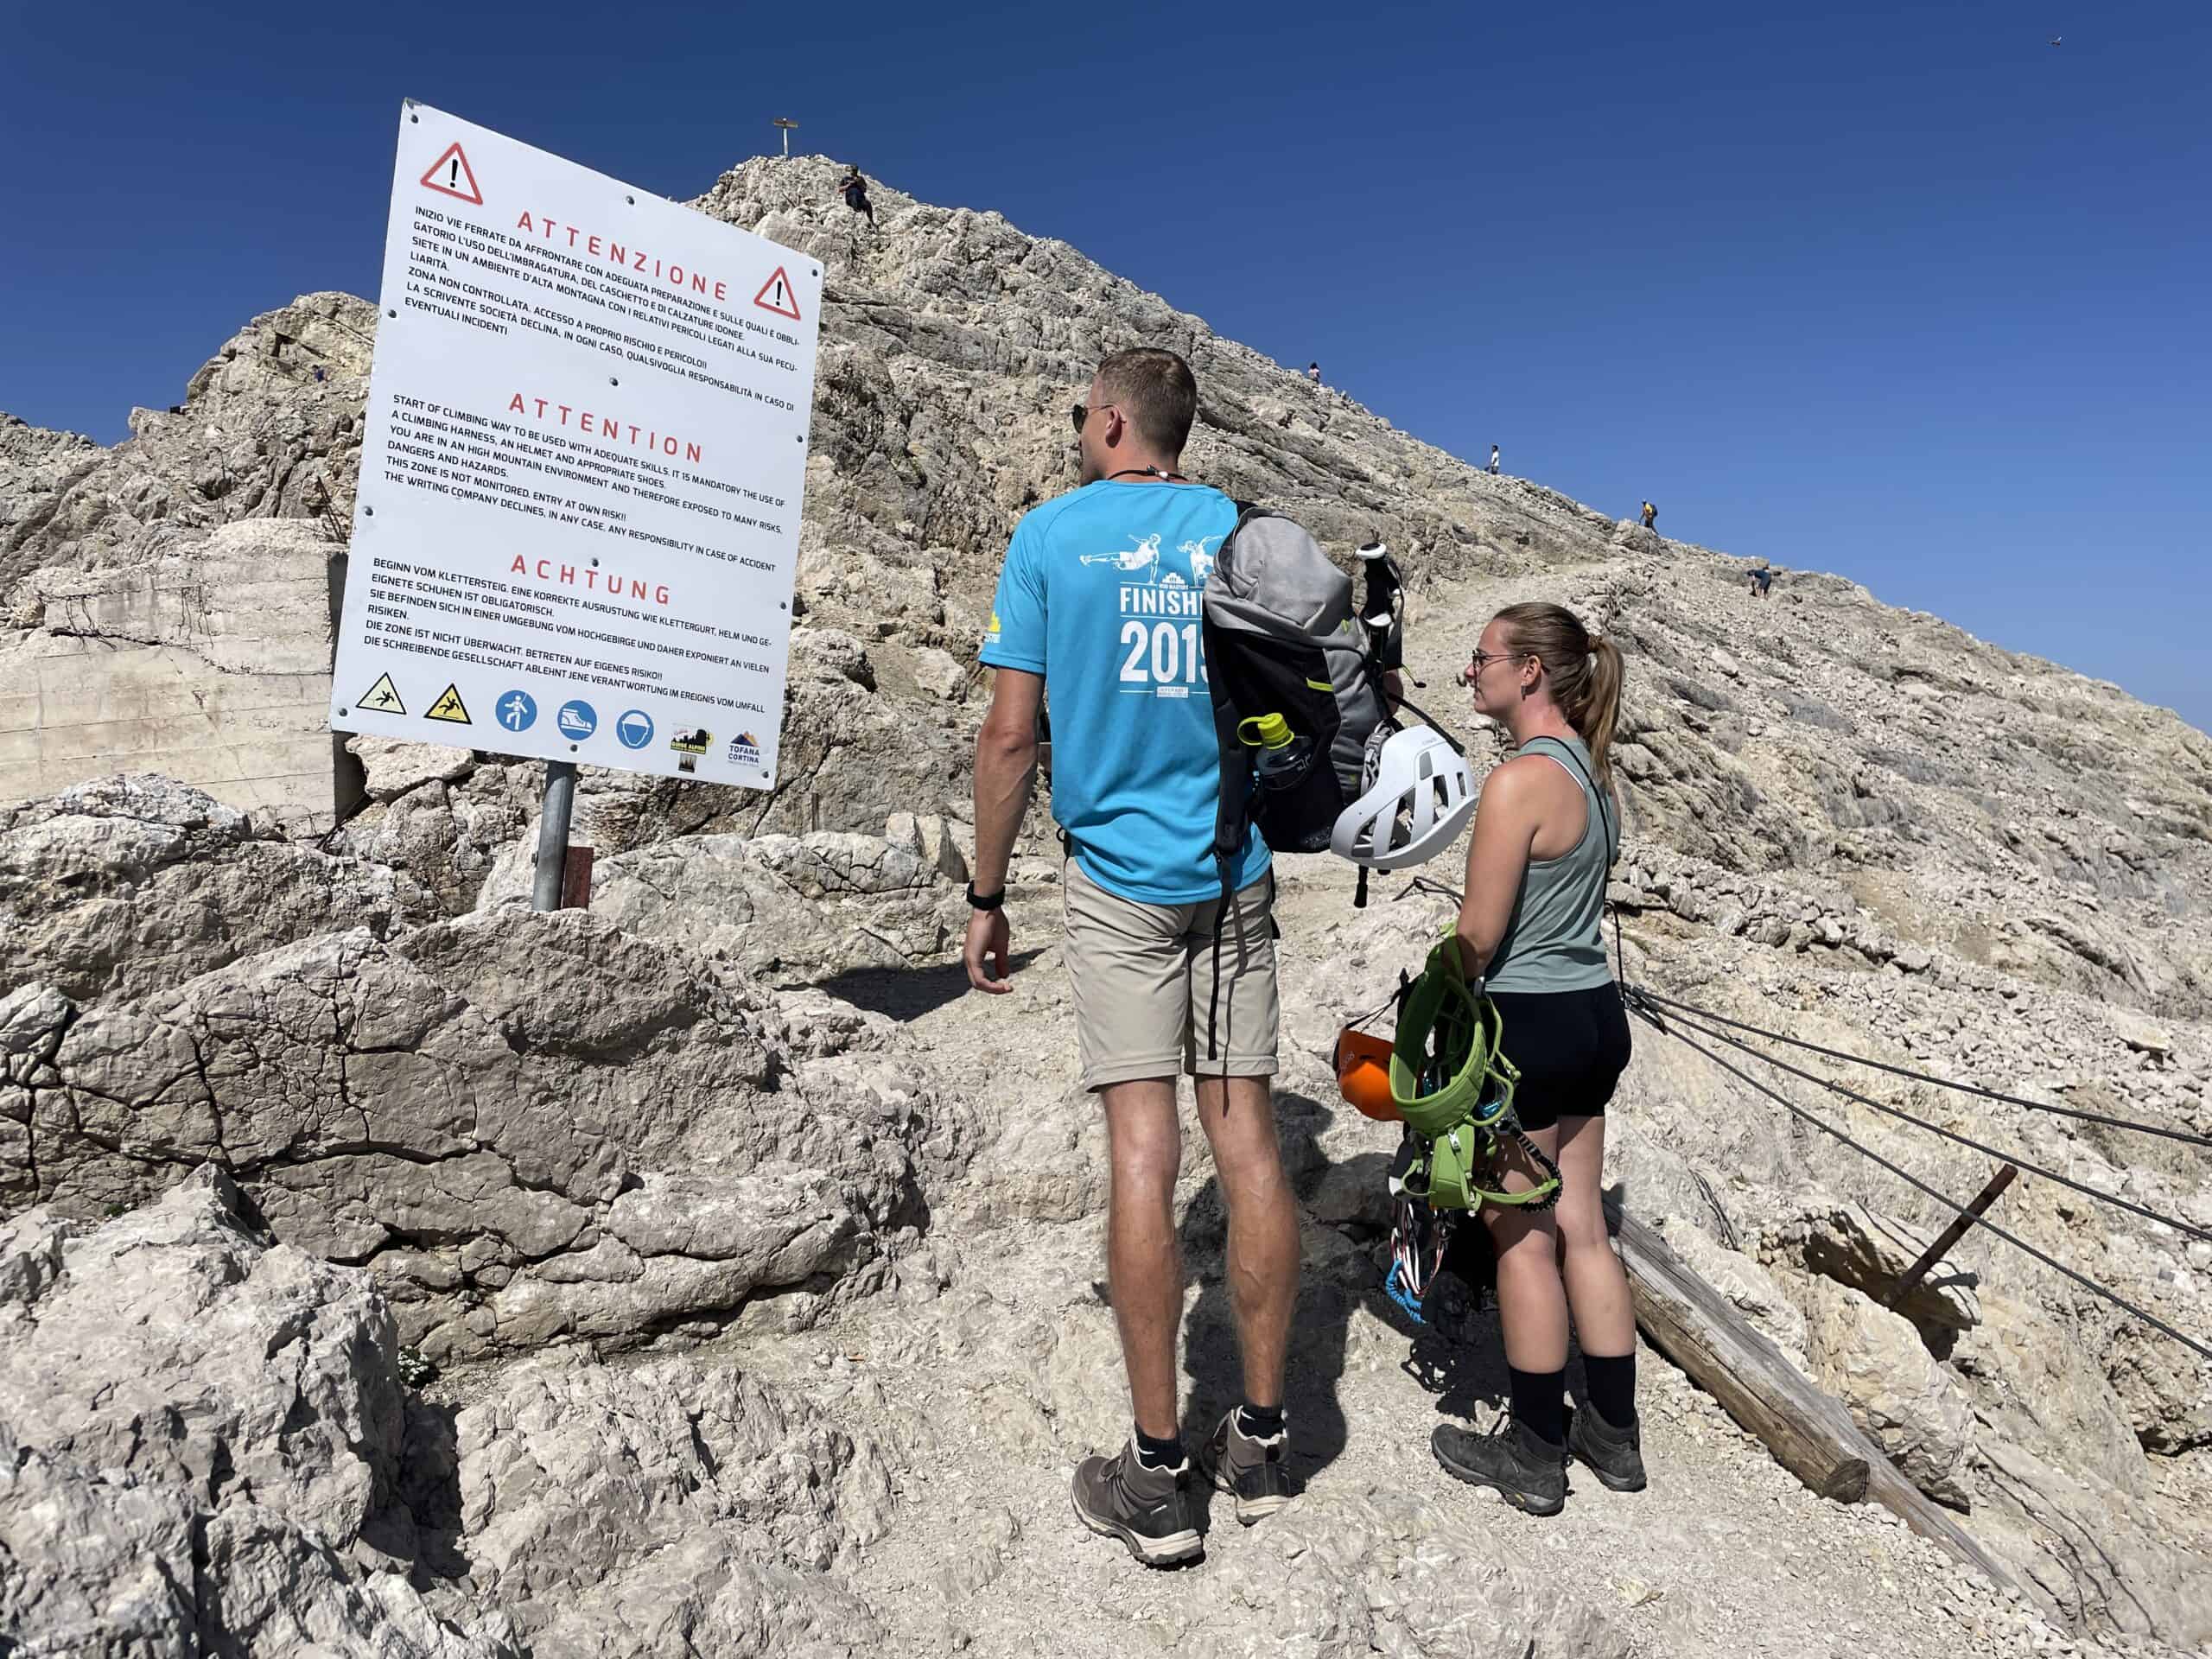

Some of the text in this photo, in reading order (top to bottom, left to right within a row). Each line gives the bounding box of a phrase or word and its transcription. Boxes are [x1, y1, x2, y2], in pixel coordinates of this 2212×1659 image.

[410, 250, 450, 271] LIARITÀ.
[413, 220, 456, 242] GATORIO
[458, 235, 486, 251] L'USO
[581, 276, 598, 290] DEL
[600, 283, 649, 308] CASCHETTO
[667, 307, 714, 330] CALZATURE
[415, 205, 799, 346] INIZIO VIE FERRATE DA AFFRONTARE CON ADEGUATA PREPARAZIONE SULLE QUALI OBBLI-
[517, 211, 727, 301] ATTENZIONE
[404, 296, 508, 335] EVENTUALI INCIDENTI
[408, 265, 436, 283] ZONA
[438, 276, 461, 290] NON
[533, 306, 575, 326] ACCESSO
[584, 321, 622, 341] PROPRIO
[623, 334, 656, 353] RISCHIO
[411, 236, 798, 372] SIETE UN AMBIENTE D'ALTA MONTAGNA CON RELATIVI PERICOLI LEGATI ALLA SUA PECU-
[406, 281, 420, 294] LA
[423, 286, 477, 311] SCRIVENTE
[479, 303, 518, 323] SOCIETÀ
[575, 334, 597, 348] OGNI
[599, 341, 624, 359] CASO,
[626, 350, 686, 377] QUALSIVOGLIA
[688, 370, 753, 398] RESPONSABILITÀ
[764, 395, 785, 409] CASO
[387, 440, 509, 478] DANGERS AND HAZARDS.
[393, 394, 426, 410] START
[442, 407, 488, 427] CLIMBING
[490, 420, 512, 433] WAY
[542, 434, 567, 448] USED
[568, 441, 592, 454] WITH
[593, 448, 639, 467] ADEQUATE
[691, 474, 741, 495] MANDATORY
[742, 489, 758, 500] THE
[759, 493, 774, 505] USE
[401, 412, 448, 432] CLIMBING
[450, 424, 498, 446] HARNESS,
[499, 438, 515, 449] AN
[516, 442, 554, 459] HELMET
[555, 453, 575, 465] AND
[576, 458, 636, 481] APPROPRIATE
[508, 393, 701, 463] ATTENTION
[386, 455, 409, 468] THIS
[410, 461, 438, 476] ZONE
[451, 471, 472, 484] NOT
[474, 476, 531, 499] MONITORED.
[532, 492, 563, 506] ENTRY
[578, 503, 601, 516] OWN
[390, 424, 411, 437] YOU
[413, 431, 435, 444] ARE
[467, 444, 491, 458] HIGH
[493, 451, 542, 472] MOUNTAIN
[544, 464, 609, 488] ENVIRONMENT
[611, 482, 631, 494] AND
[632, 486, 681, 507] THEREFORE
[682, 500, 719, 517] EXPOSED
[734, 514, 758, 527] MANY
[384, 470, 404, 484] THE
[406, 476, 449, 494] WRITING
[451, 486, 499, 505] COMPANY
[500, 498, 546, 518] DECLINES,
[559, 512, 580, 524] ANY
[607, 524, 627, 537] ANY
[628, 529, 695, 552] RESPONSIBILITY
[705, 548, 727, 561] CASE
[739, 556, 777, 572] ACCIDENT
[367, 604, 410, 620] RISIKEN.
[372, 573, 555, 617] EIGNETE SCHUHEN IST OBLIGATORISCH.
[373, 557, 411, 573] BEGINN
[413, 565, 436, 578] VOM
[438, 570, 509, 594] KLETTERSTEIG.
[511, 586, 532, 598] EINE
[533, 590, 580, 607] KORREKTE
[641, 613, 658, 624] WIE
[718, 629, 740, 640] HELM
[741, 633, 758, 645] UND
[759, 638, 772, 647] GE-
[511, 555, 669, 605] ACHTUNG
[1120, 588, 1203, 615] FINISH
[365, 620, 384, 631] DIE
[385, 623, 413, 636] ZONE
[414, 628, 430, 639] IST
[432, 632, 462, 645] NICHT
[525, 648, 572, 664] BETRETEN
[574, 657, 593, 668] AUF
[594, 661, 630, 675] EIGENES
[370, 588, 770, 674] SIE BEFINDEN SICH EINER UMGEBUNG VOM HOCHGEBIRGE UND DAHER EXPONIERT VIELEN
[1120, 620, 1209, 684] 201
[364, 635, 766, 714] DIE SCHREIBENDE GESELLSCHAFT ABLEHNT JENE VERANTWORTUNG EREIGNIS VOM UMFALL
[728, 753, 760, 764] CORTINA
[729, 745, 760, 756] TOFANA
